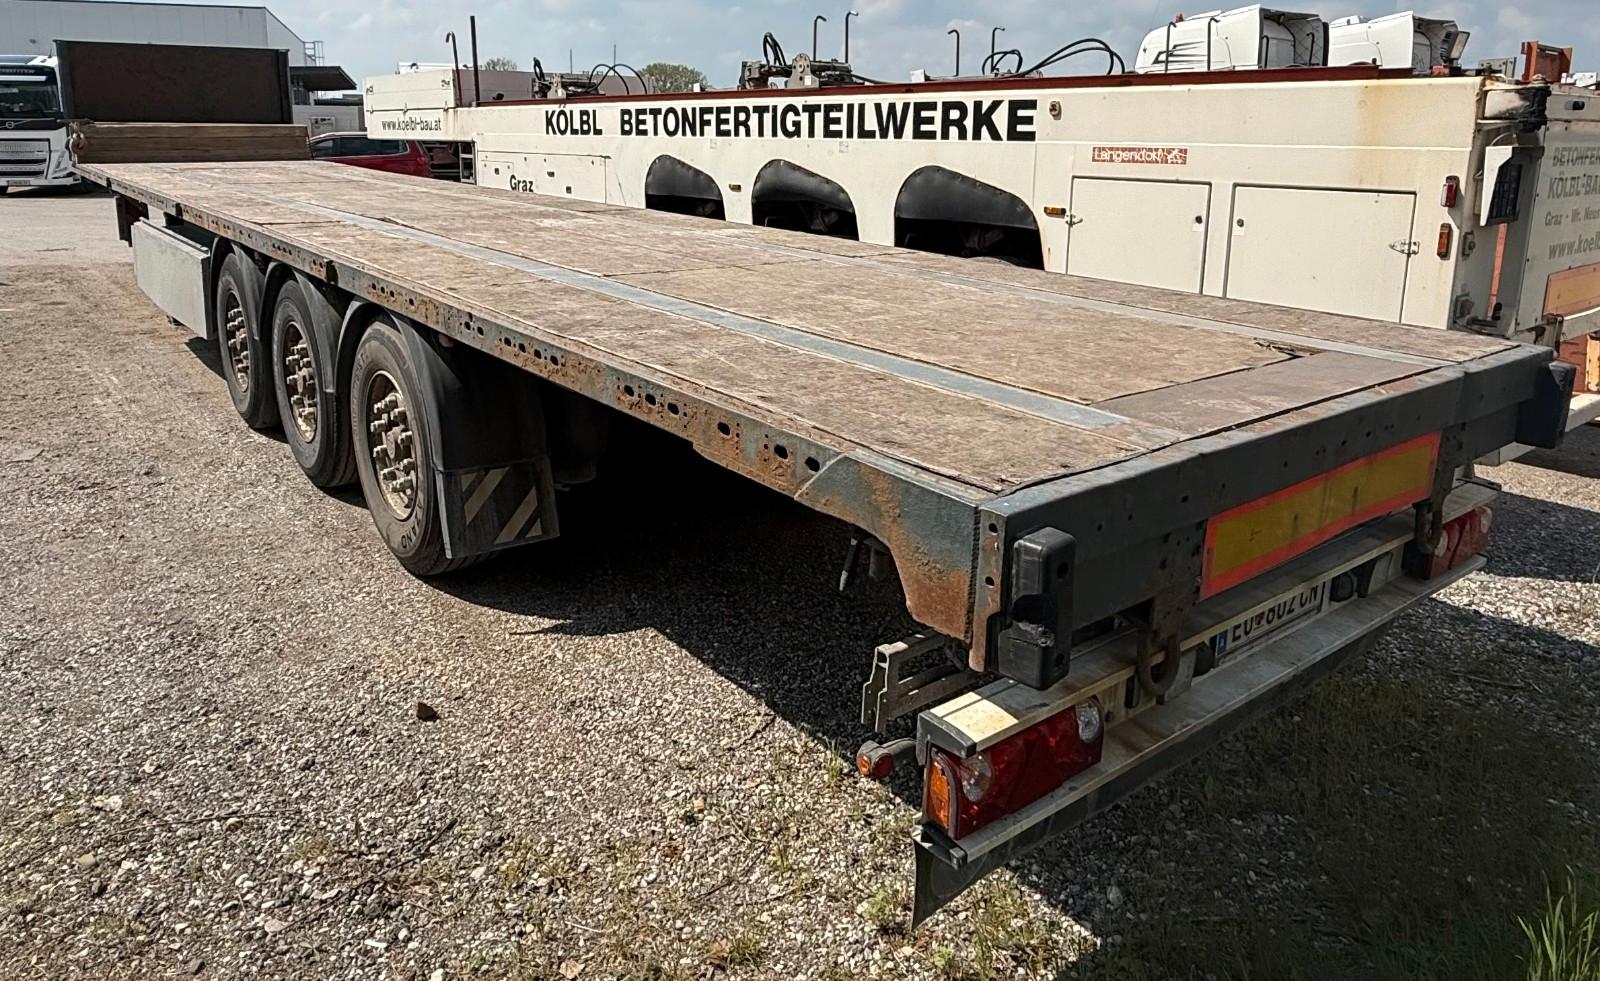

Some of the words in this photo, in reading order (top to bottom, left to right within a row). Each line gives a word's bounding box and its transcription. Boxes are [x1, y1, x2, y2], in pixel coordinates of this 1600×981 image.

[381, 117, 442, 131] www.koelbl-bau.at
[545, 104, 603, 136] KÖLBL
[620, 99, 1038, 142] BETONFERTIGTEILWERKE
[509, 174, 534, 193] Graz
[1544, 211, 1563, 226] Graz
